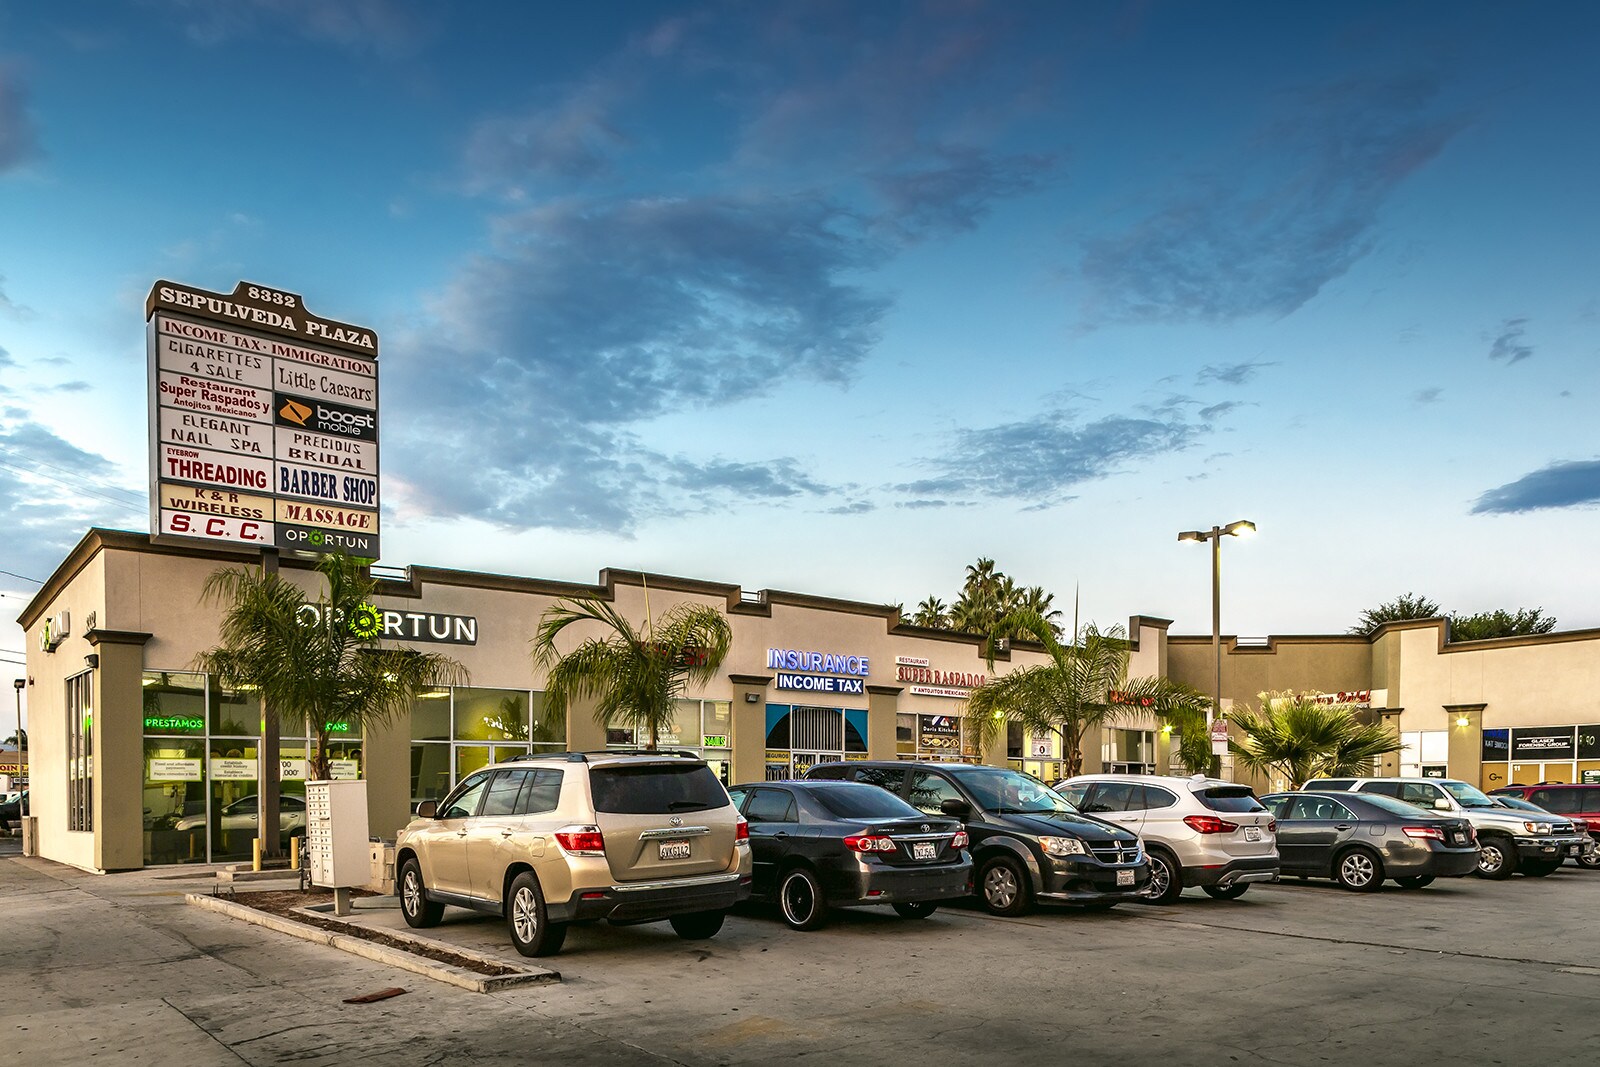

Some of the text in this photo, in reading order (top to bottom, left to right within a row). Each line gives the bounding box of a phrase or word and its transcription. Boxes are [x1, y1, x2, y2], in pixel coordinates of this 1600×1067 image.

[248, 286, 296, 308] 8332
[160, 286, 374, 349] SEPULVEDA PLAZA
[165, 321, 228, 344] INCOME
[272, 344, 372, 375] IMMIGRATION
[168, 340, 262, 369] CIGARETTES
[190, 361, 243, 381] 4 SALE
[180, 376, 257, 398] Restaurant
[278, 367, 372, 402] Little Caesars
[160, 381, 270, 414] Super Raspados y
[173, 397, 257, 419] Antojitos Mexicanos
[182, 414, 251, 436] ELEGANT
[317, 405, 374, 429] boost
[318, 420, 361, 436] mobile
[171, 428, 262, 453] NAIL SPA
[167, 447, 199, 459] EYEBROW
[288, 448, 367, 470] BRIDAL
[167, 458, 267, 489] THREADING
[194, 488, 239, 503] K & R
[280, 467, 376, 505] BARBER SHOP
[170, 497, 263, 519] WIRELESS
[285, 504, 371, 529] MASSAGE
[286, 529, 368, 549] OPORTUN
[767, 648, 869, 676] INSURANCE
[898, 656, 928, 667] RESTAURANT
[779, 674, 863, 694] INCOME TAX
[898, 666, 985, 688] SUPER RASPADOS
[918, 688, 943, 696] ANTOJITOS
